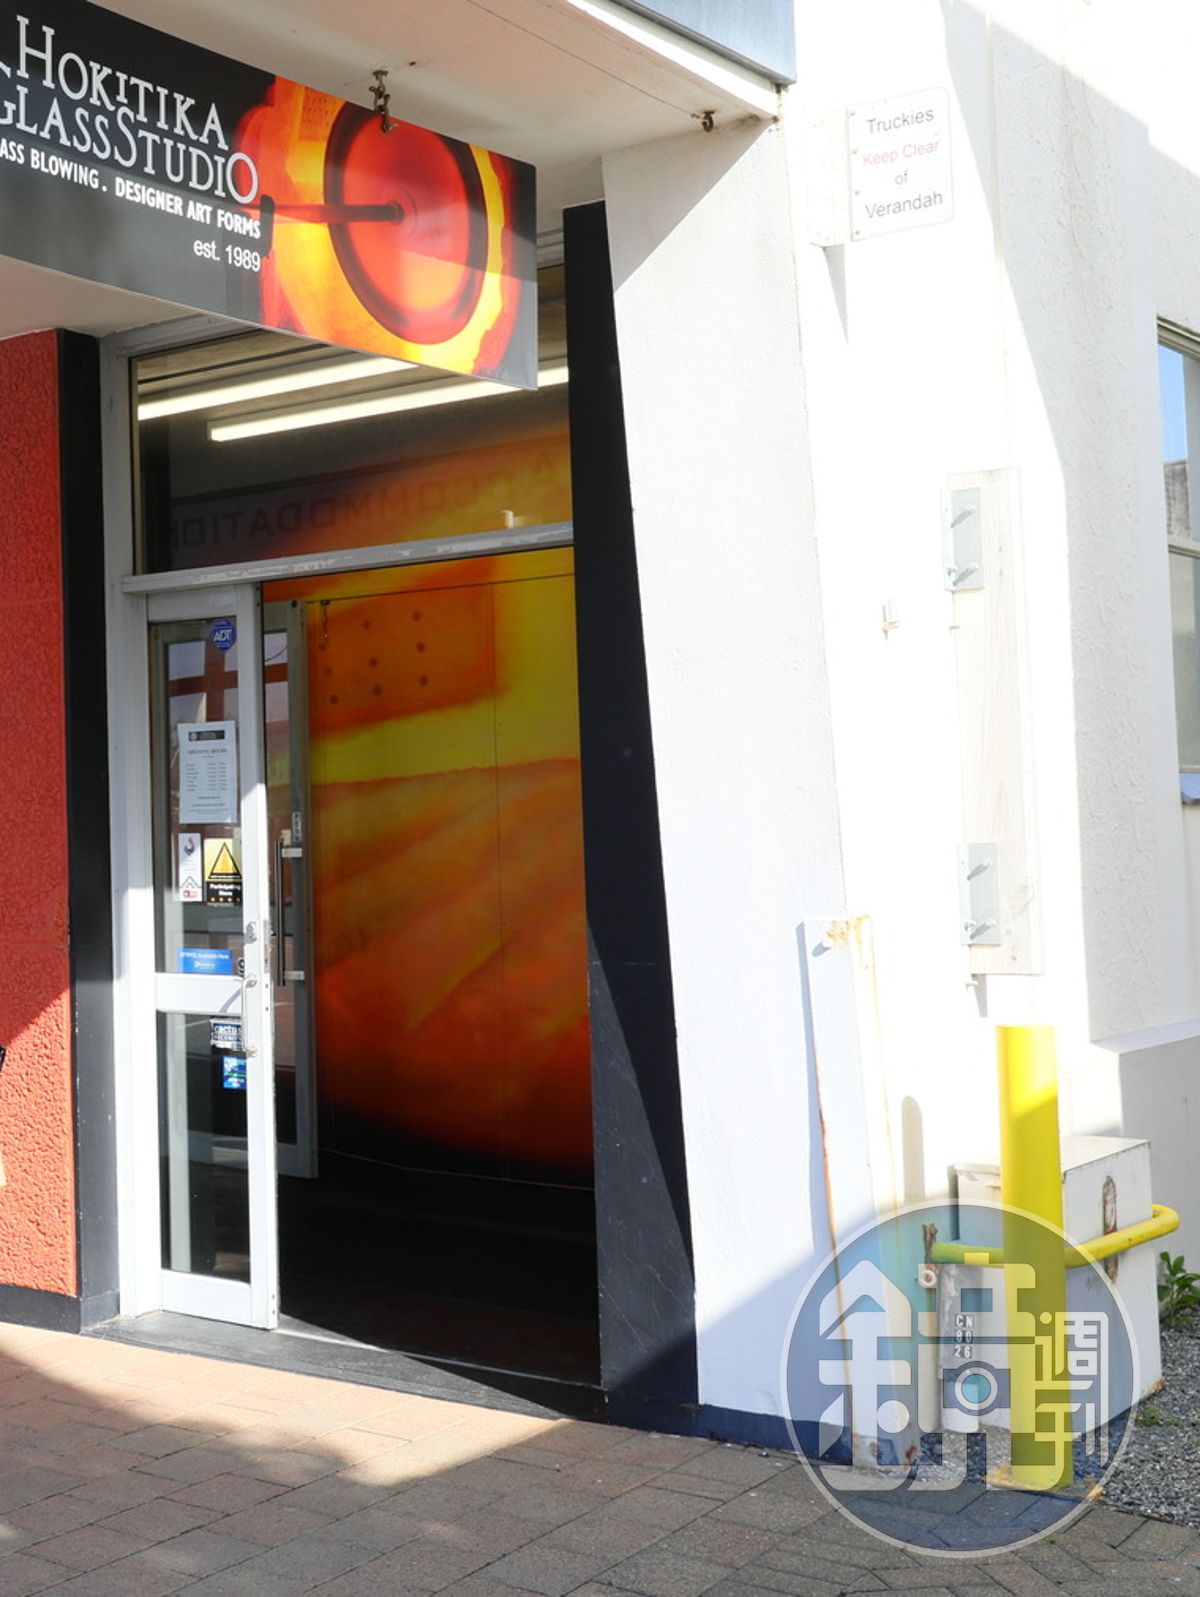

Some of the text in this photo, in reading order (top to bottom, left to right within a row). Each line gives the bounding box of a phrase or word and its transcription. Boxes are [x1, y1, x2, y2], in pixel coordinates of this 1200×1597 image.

[16, 14, 229, 151] HOKITIKA
[867, 109, 935, 134] Truckies
[863, 141, 940, 167] Keep Clear
[895, 170, 909, 186] of
[115, 177, 184, 217] DESIGNER
[187, 200, 213, 225] ART
[217, 210, 261, 240] FORMS
[865, 191, 944, 219] Verandah
[193, 240, 260, 273] est. 1989
[212, 629, 233, 642] ADT
[956, 1314, 974, 1328] CN
[956, 1330, 972, 1343] 80
[954, 1344, 971, 1358] 26
